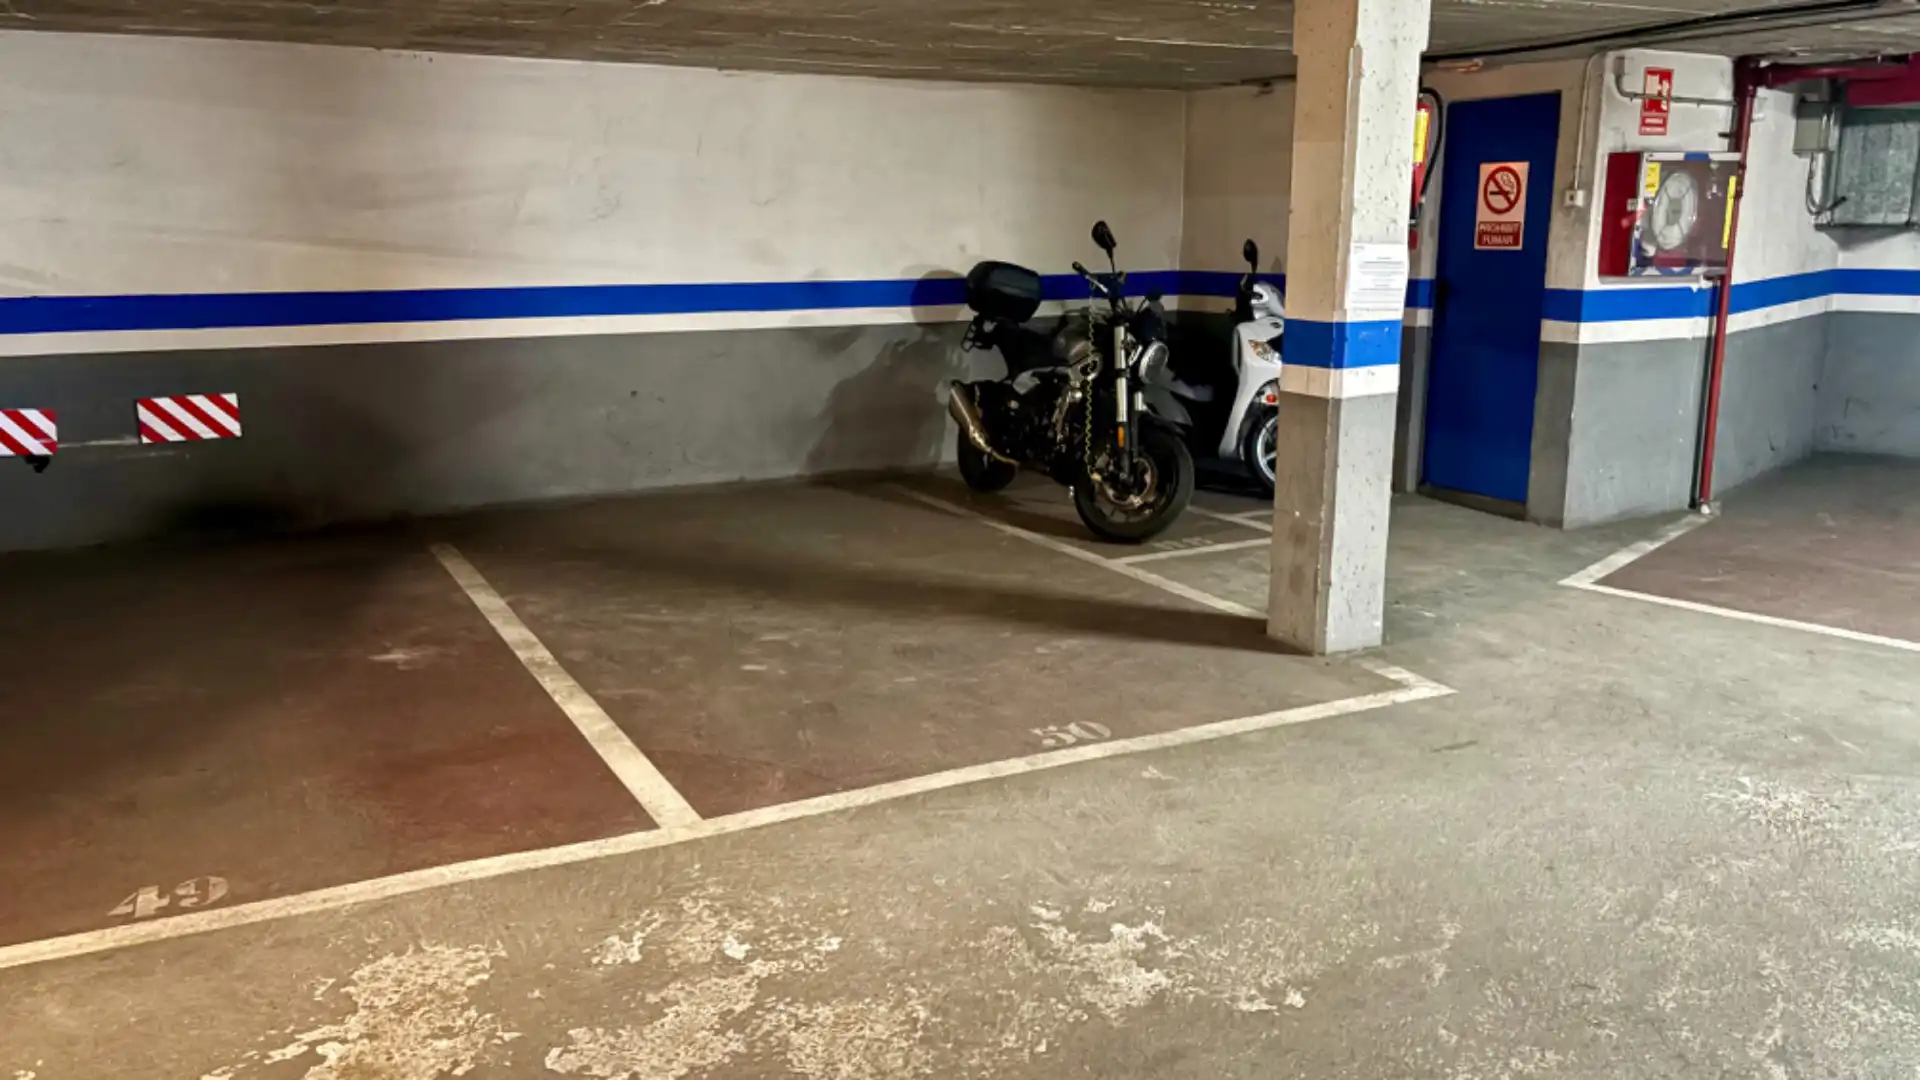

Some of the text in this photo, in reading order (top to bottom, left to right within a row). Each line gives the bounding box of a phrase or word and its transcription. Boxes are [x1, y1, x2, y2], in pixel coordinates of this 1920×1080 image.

[1482, 234, 1514, 245] FUMAR
[1028, 721, 1111, 746] 50
[106, 876, 229, 918] 49
